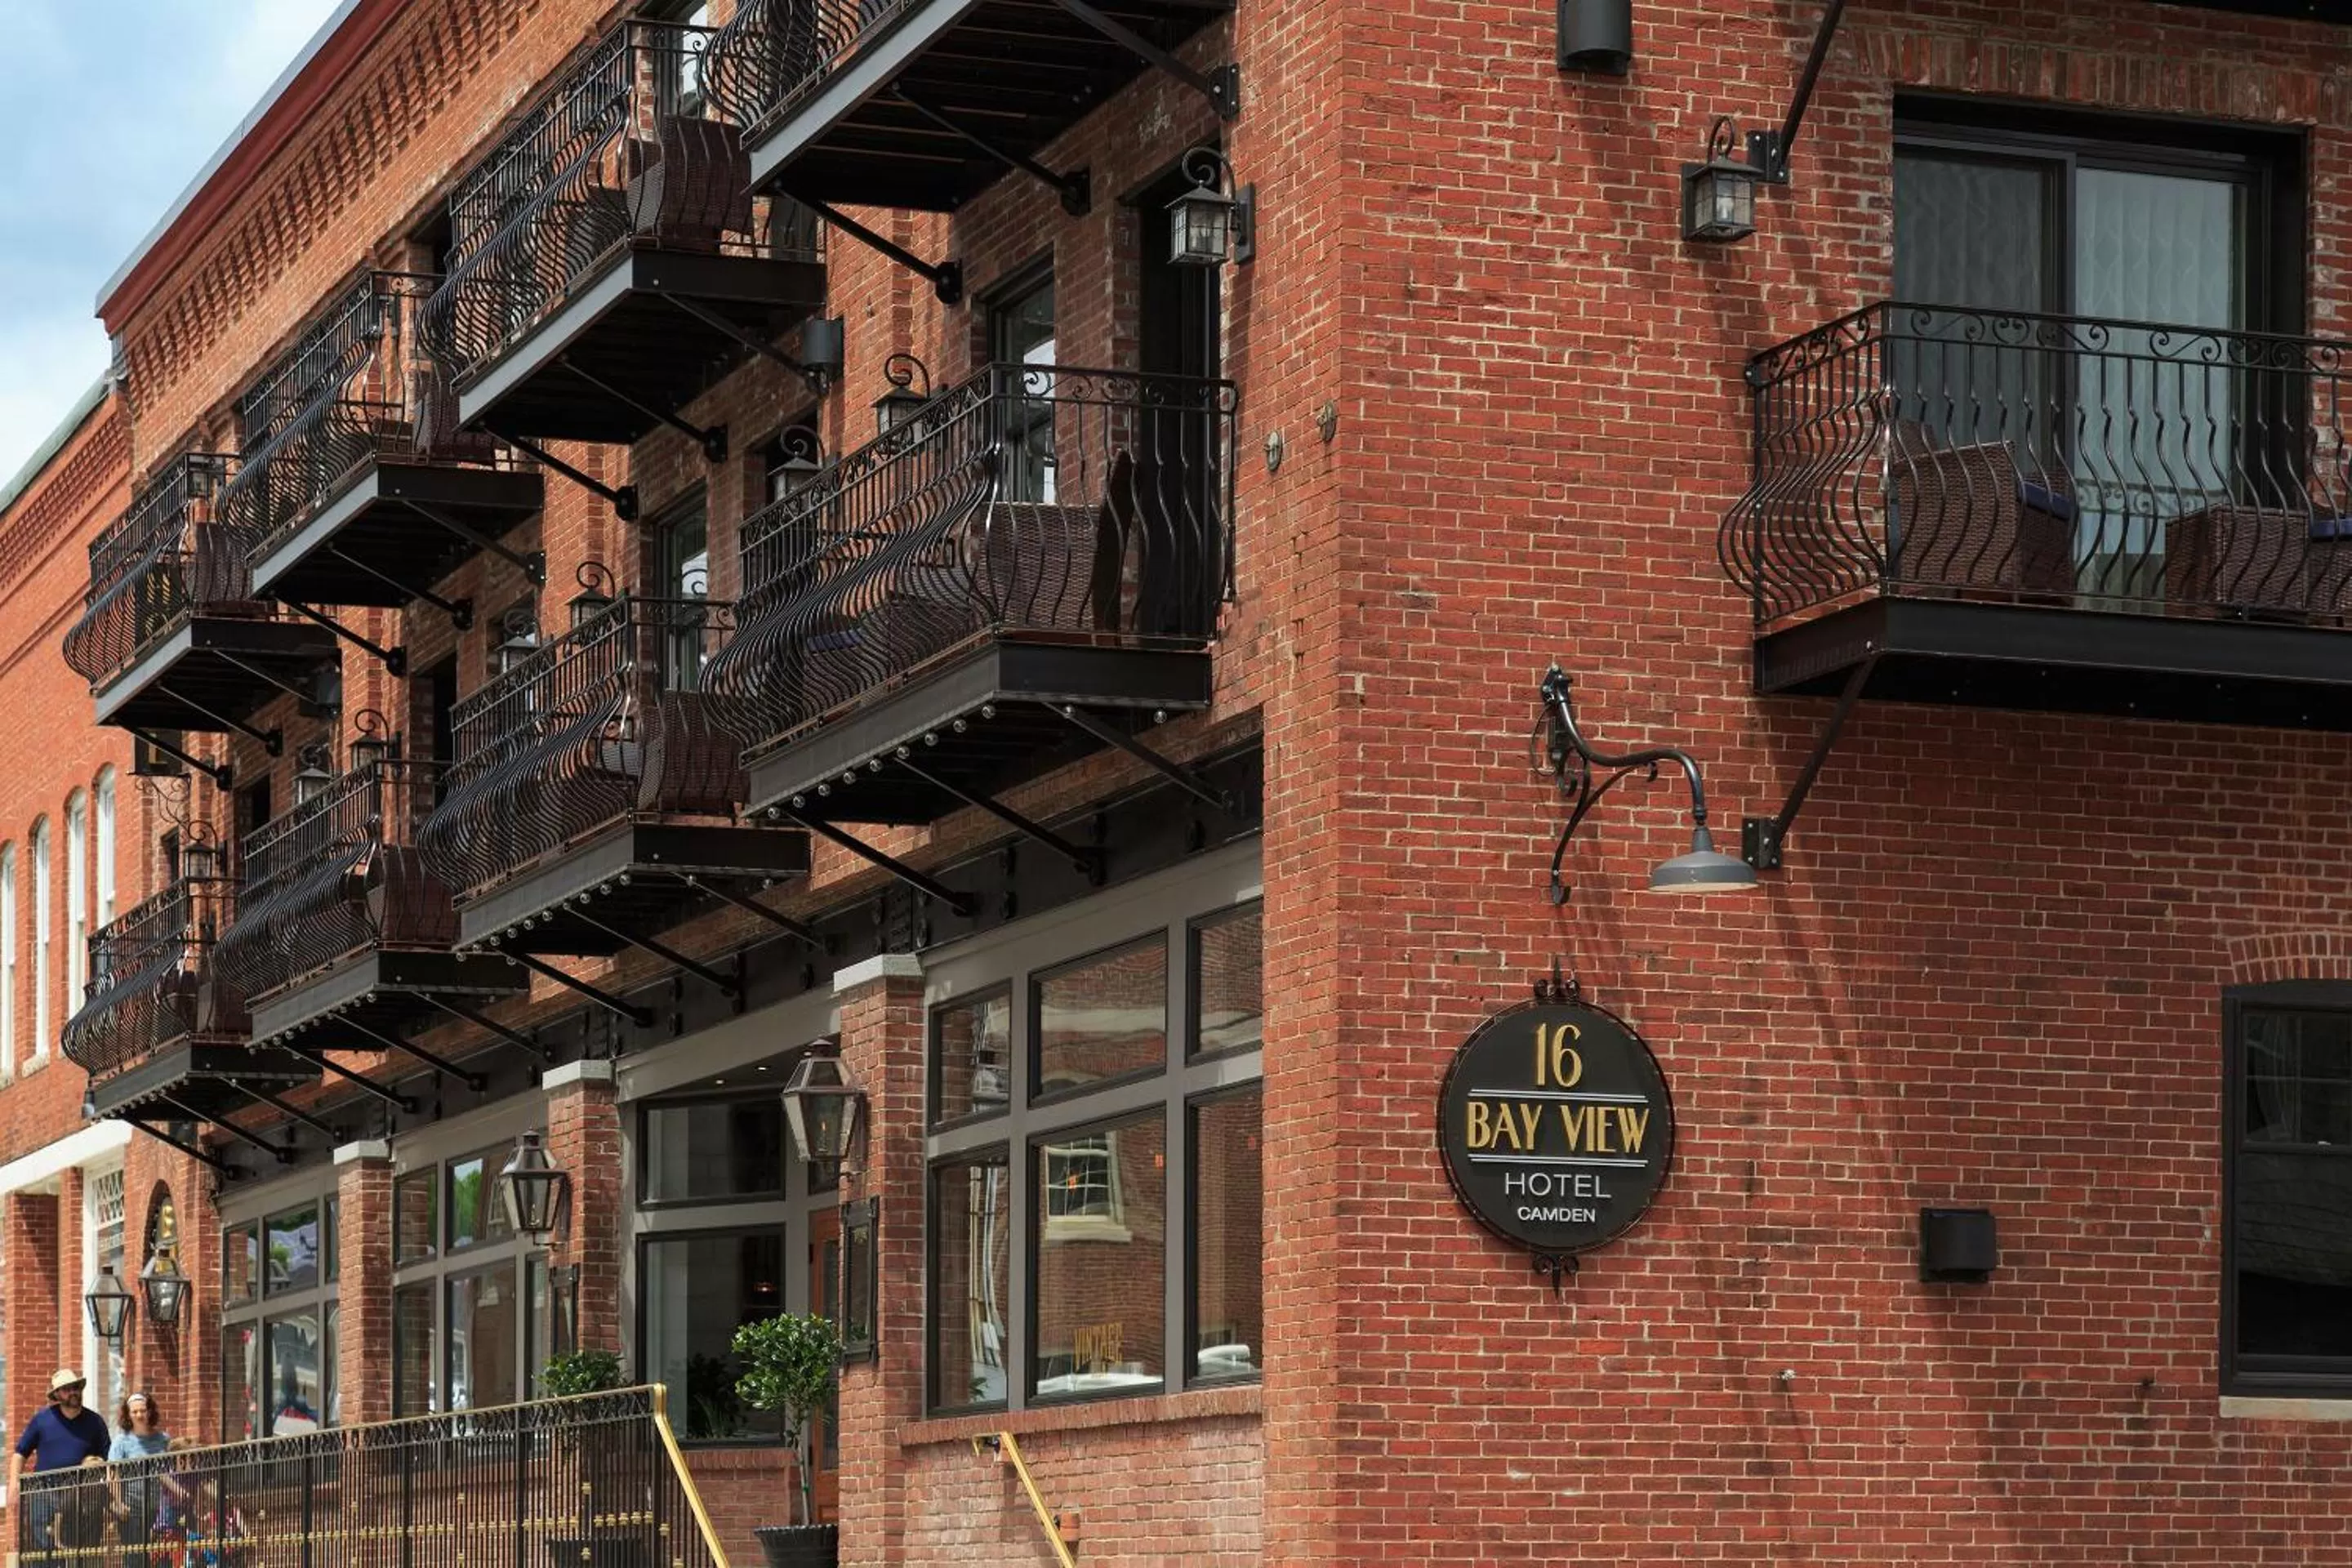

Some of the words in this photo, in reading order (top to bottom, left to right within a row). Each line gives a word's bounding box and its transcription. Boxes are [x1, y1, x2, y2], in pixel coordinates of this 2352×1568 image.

[1535, 1022, 1583, 1088] 16
[1467, 1102, 1543, 1151] BAY
[1559, 1104, 1650, 1154] VIEW
[1504, 1171, 1612, 1199] HOTEL
[1517, 1206, 1597, 1223] CAMDEN
